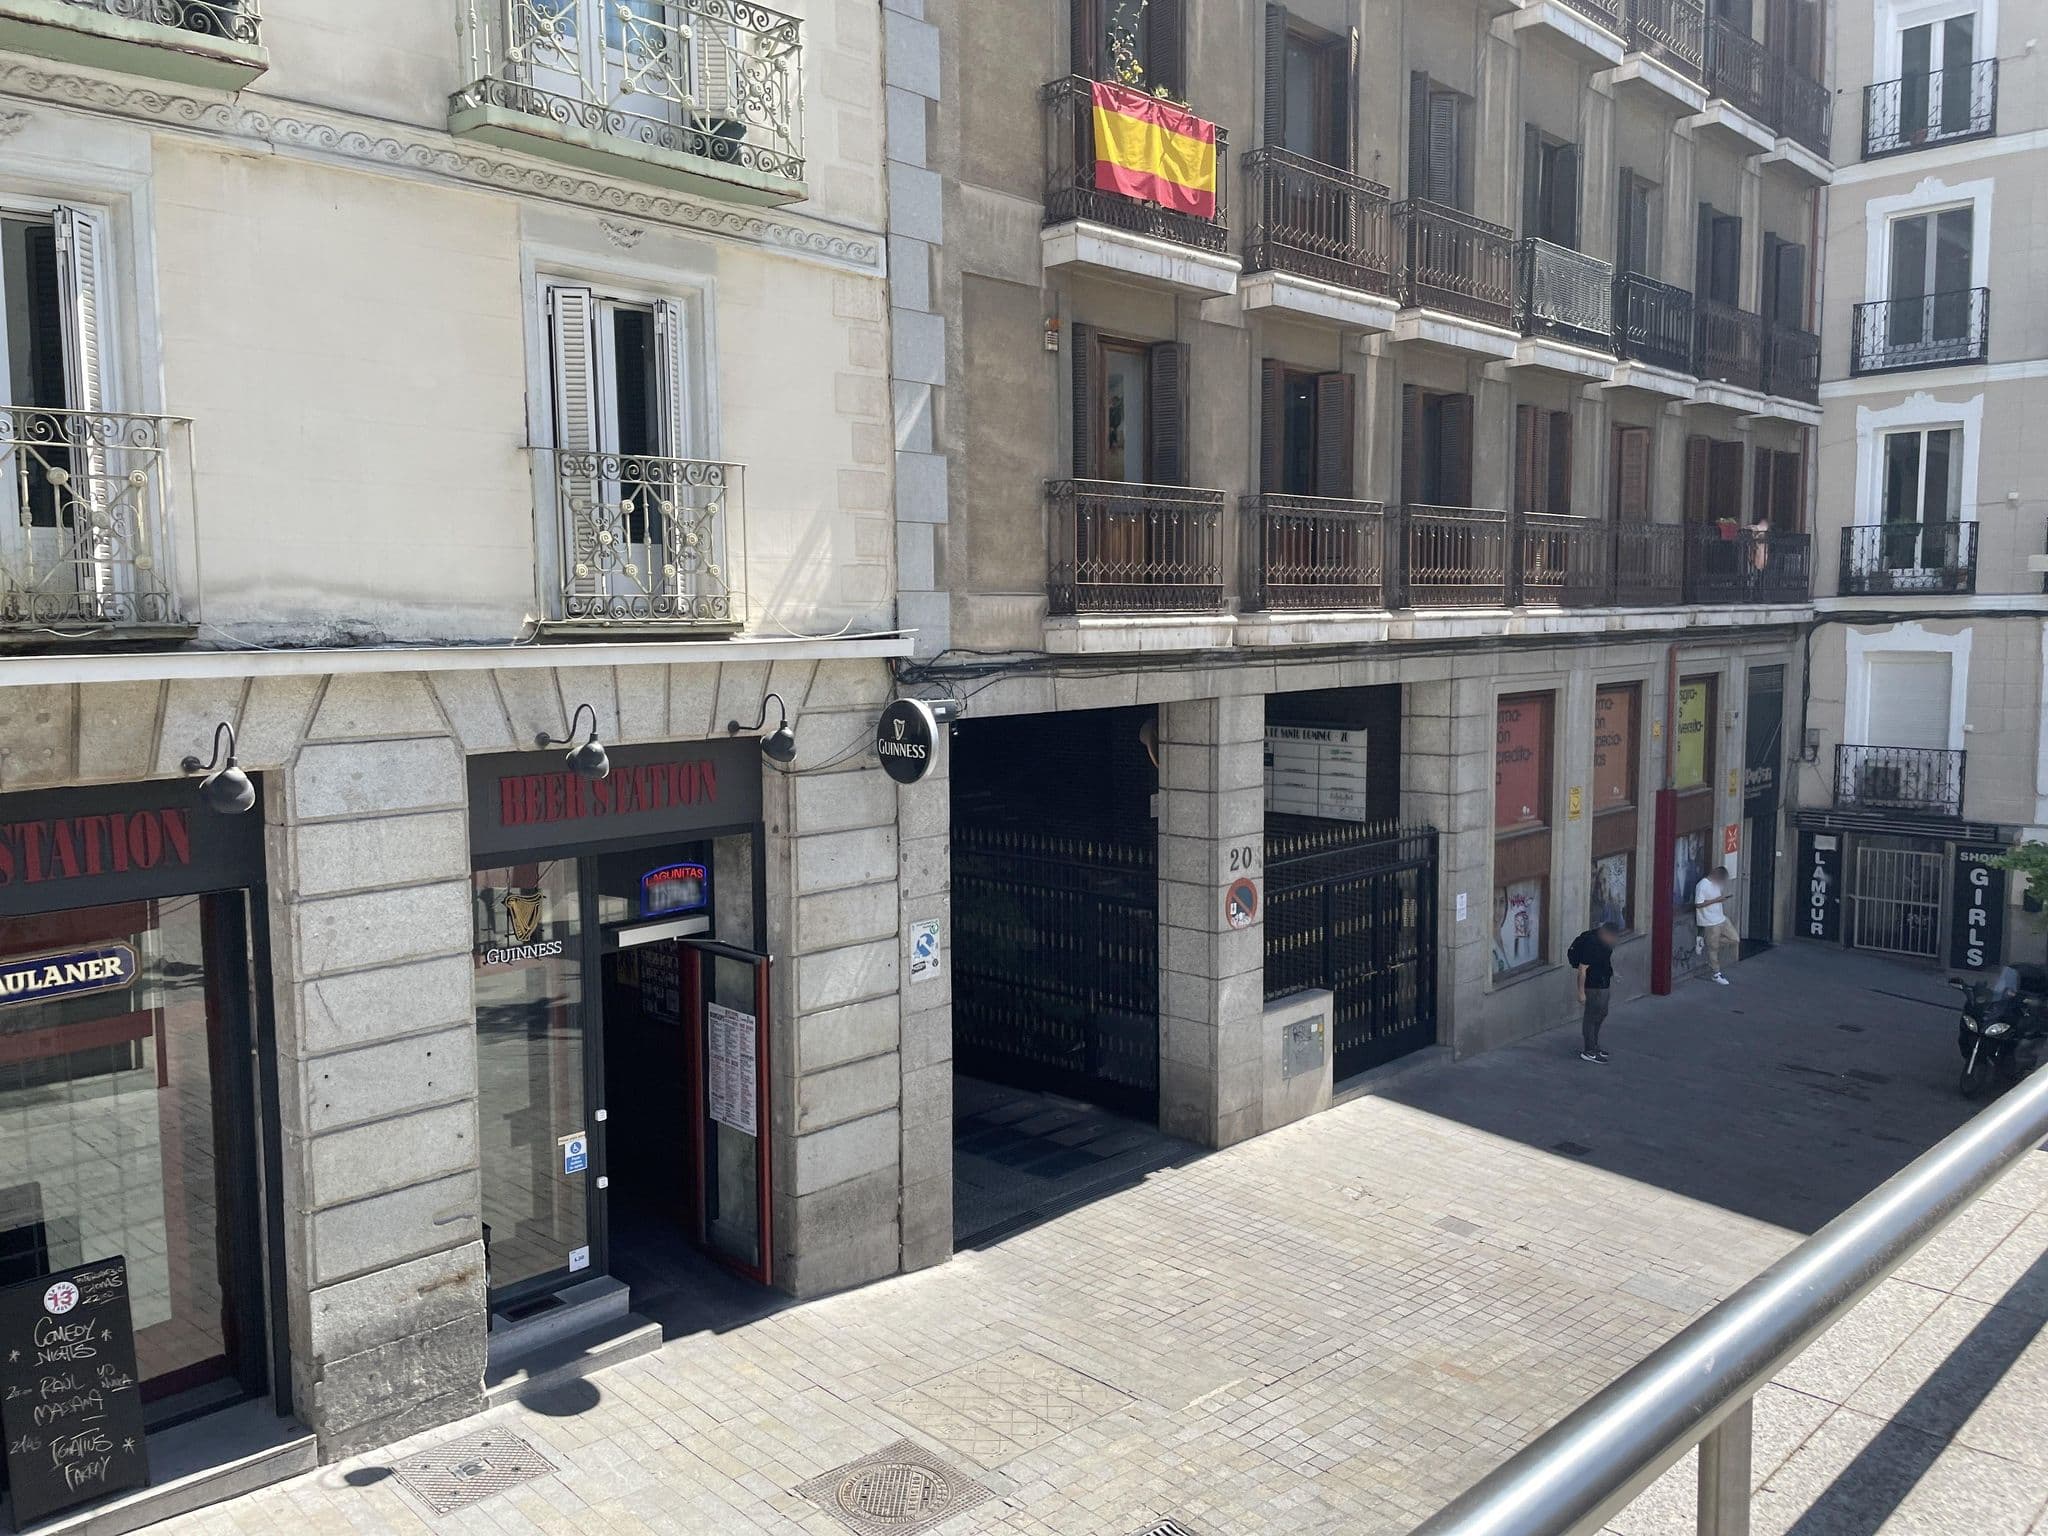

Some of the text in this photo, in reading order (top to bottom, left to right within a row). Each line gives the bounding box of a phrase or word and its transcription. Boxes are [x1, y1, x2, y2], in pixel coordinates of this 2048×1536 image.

[878, 738, 926, 760] GUINNESS
[500, 760, 718, 828] BEER STATION
[0, 807, 192, 887] STATION
[1230, 846, 1252, 872] 20
[645, 867, 704, 888] LAGUNITAS
[1810, 851, 1826, 936] LAMOUR
[1966, 867, 1989, 967] GIRLS
[487, 940, 562, 965] GUINNESS
[34, 1317, 95, 1347] COMEDY
[34, 1344, 97, 1367] NIGHTS
